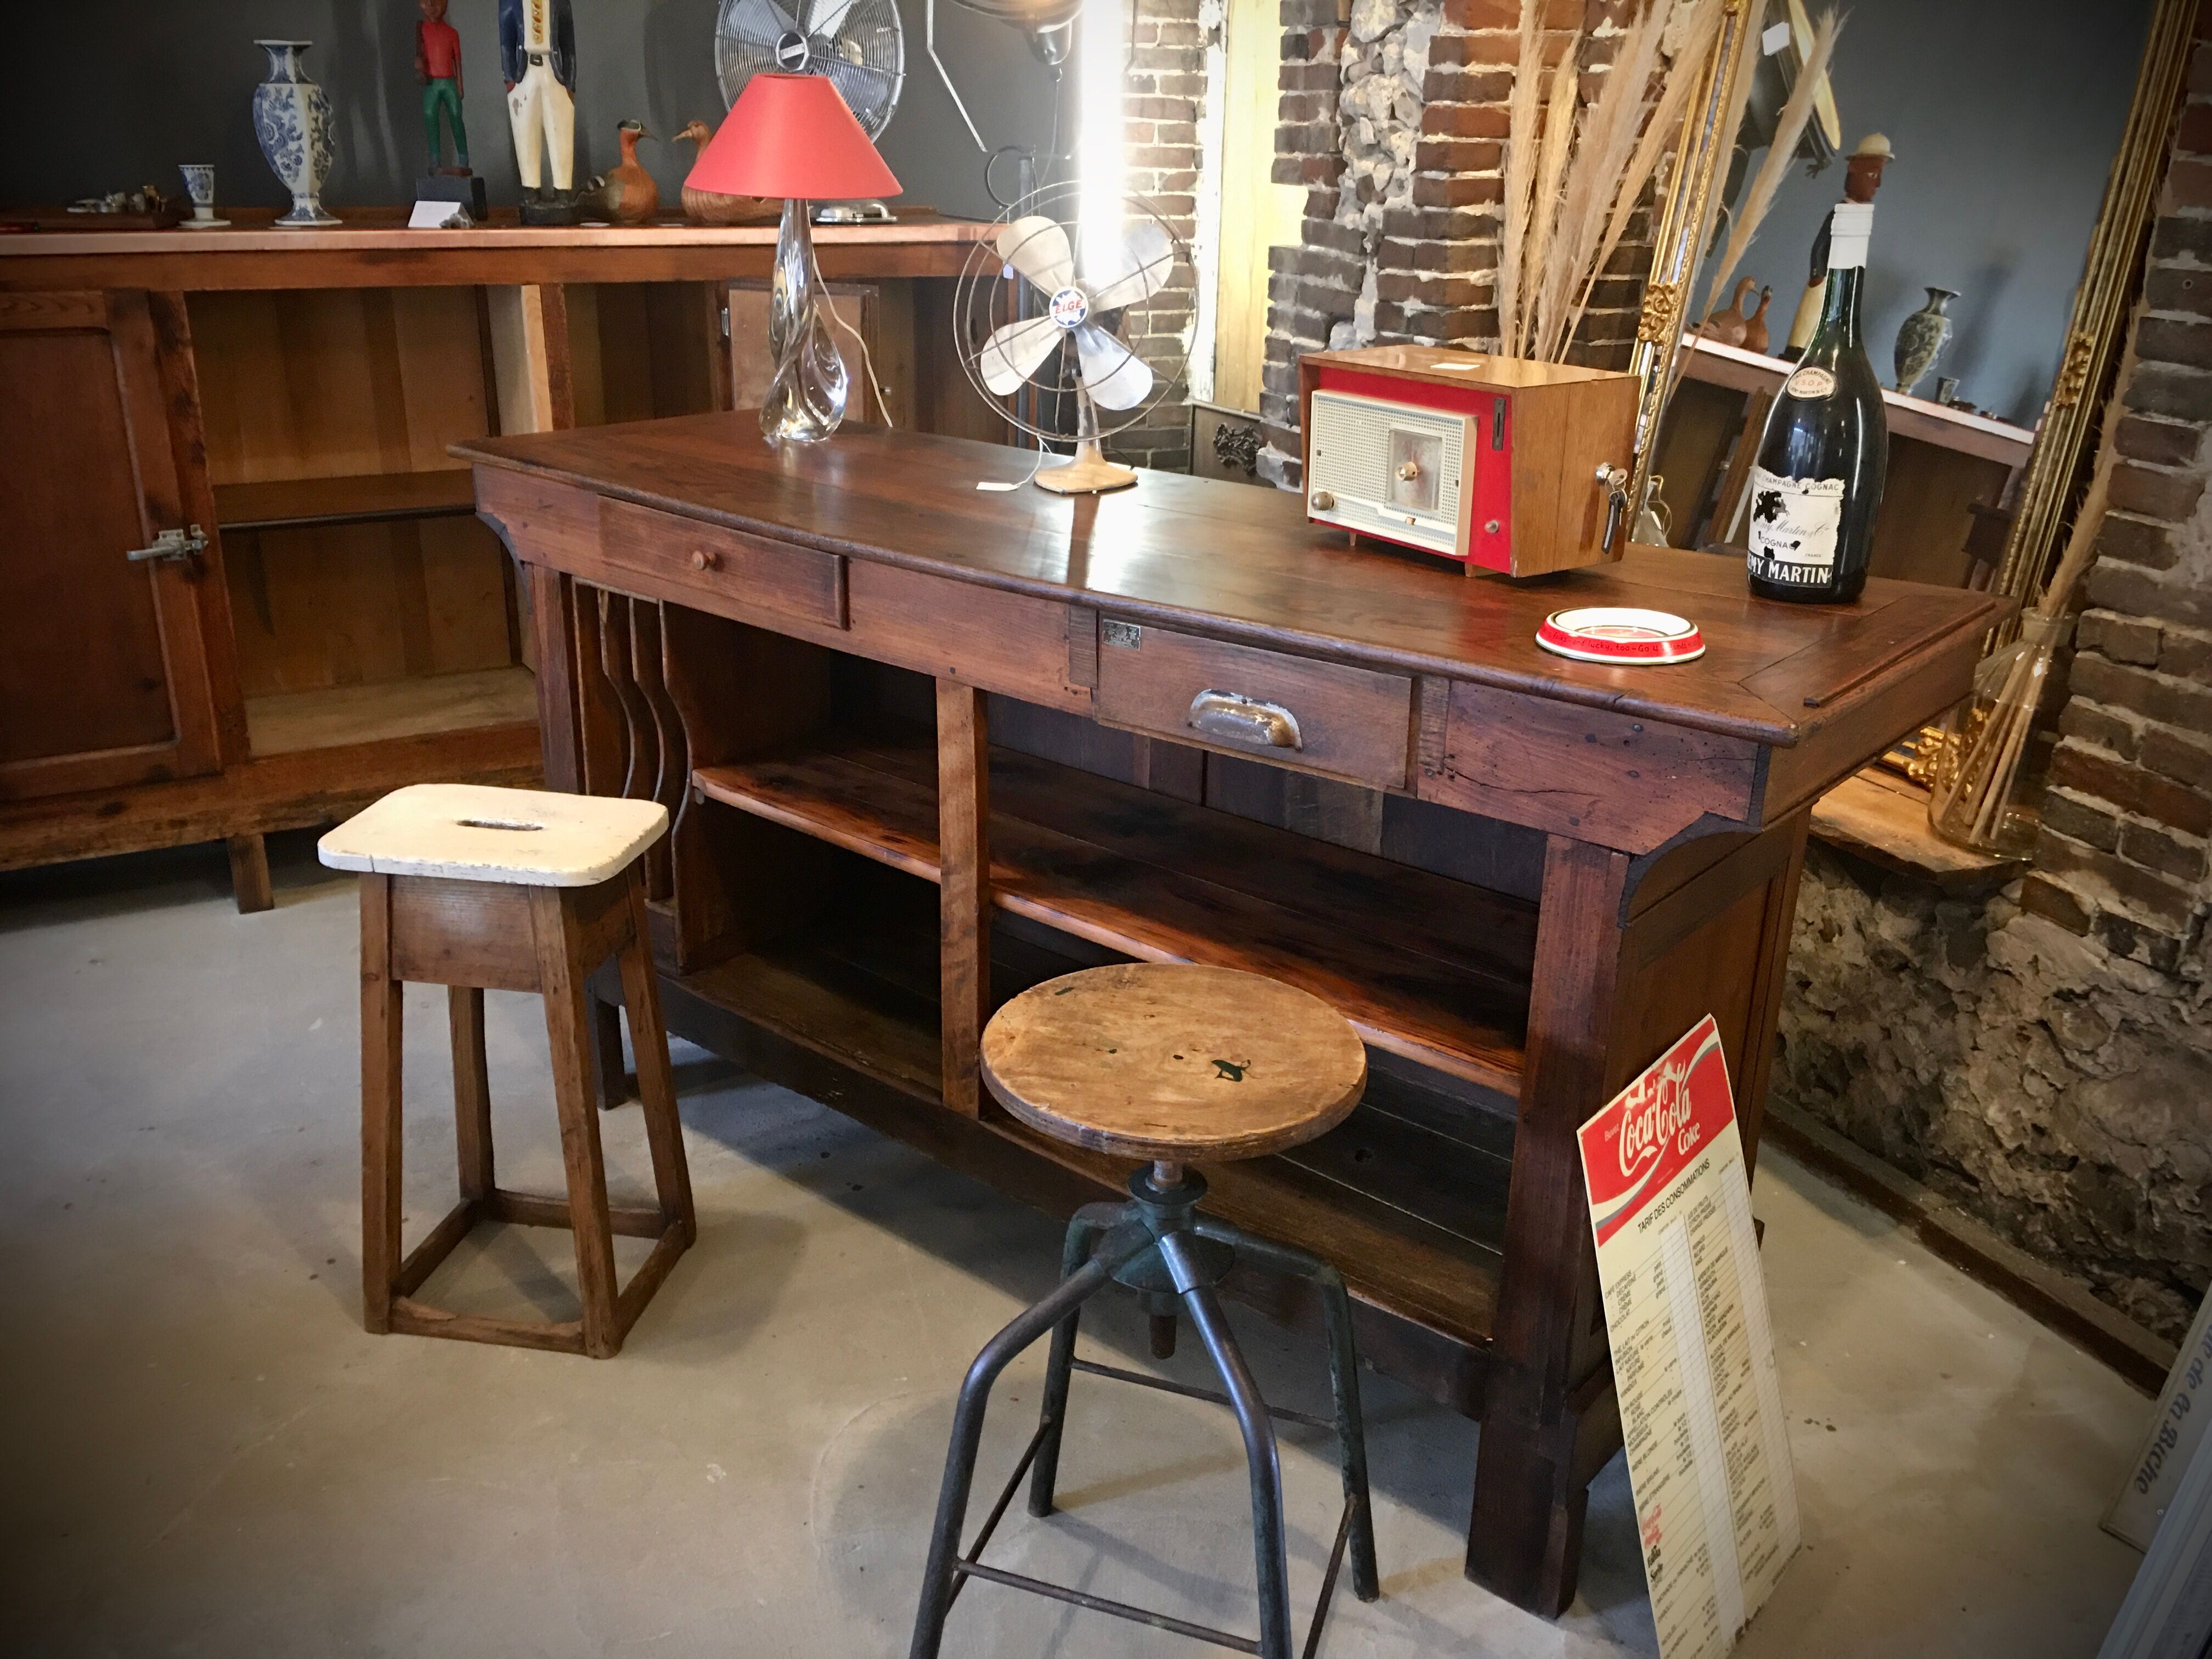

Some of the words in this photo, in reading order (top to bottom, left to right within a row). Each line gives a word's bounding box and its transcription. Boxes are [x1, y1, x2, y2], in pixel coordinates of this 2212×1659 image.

[1056, 298, 1082, 314] ELGE
[1805, 482, 1839, 491] COGNAC
[1768, 562, 1830, 584] MARTIN
[1588, 640, 1613, 651] lucky,
[1619, 1059, 1692, 1177] Coca-Cola
[1678, 1122, 1701, 1156] Coke
[1637, 1212, 1653, 1234] TARIF
[1654, 1201, 1666, 1220] DES
[1665, 1158, 1710, 1209] CONSOMMATIONS
[2170, 1392, 2191, 1420] la
[2136, 1419, 2179, 1495] Biche
